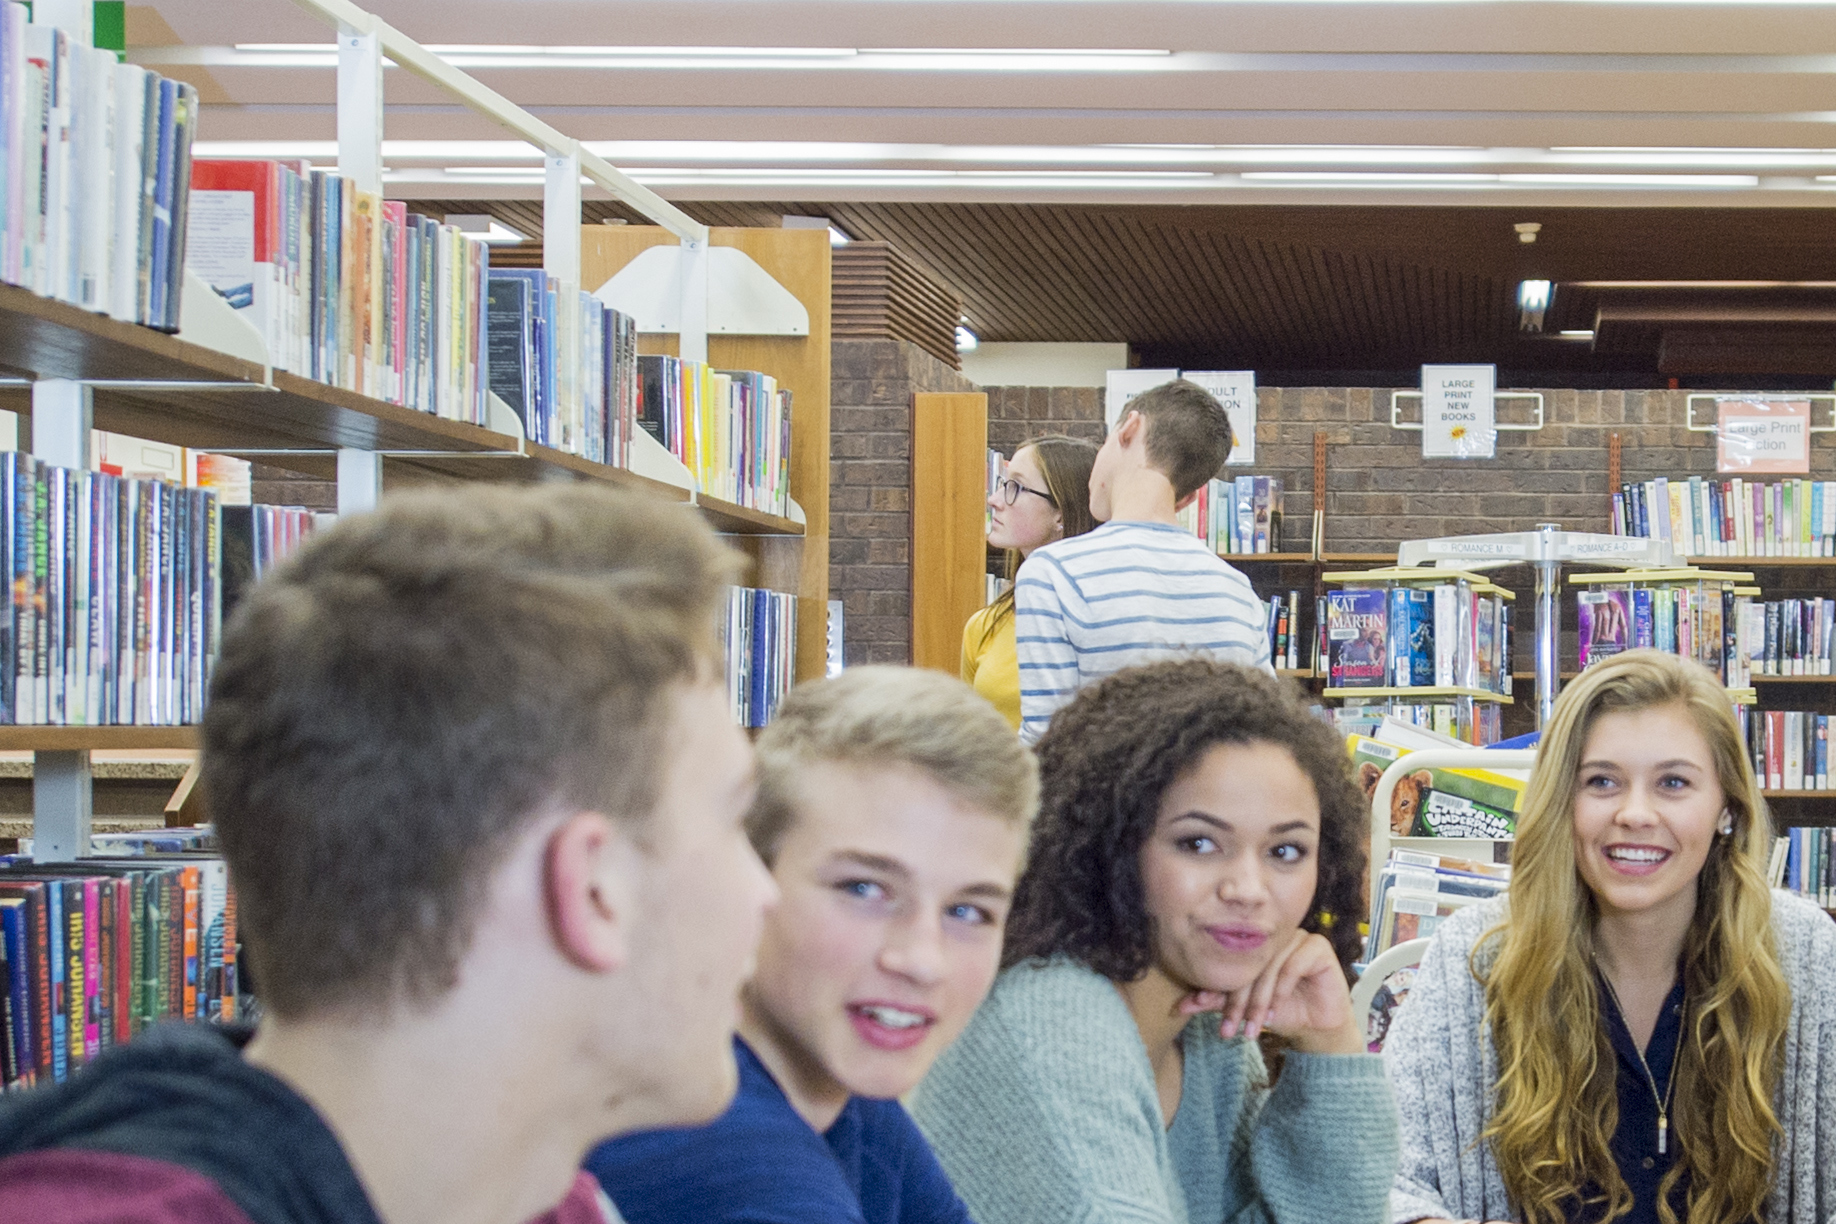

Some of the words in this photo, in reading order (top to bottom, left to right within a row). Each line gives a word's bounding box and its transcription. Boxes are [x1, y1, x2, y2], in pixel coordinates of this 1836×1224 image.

[1771, 421, 1801, 433] Print
[1332, 598, 1357, 612] KAT
[1332, 614, 1384, 629] MARTIN
[186, 890, 198, 942] EVE
